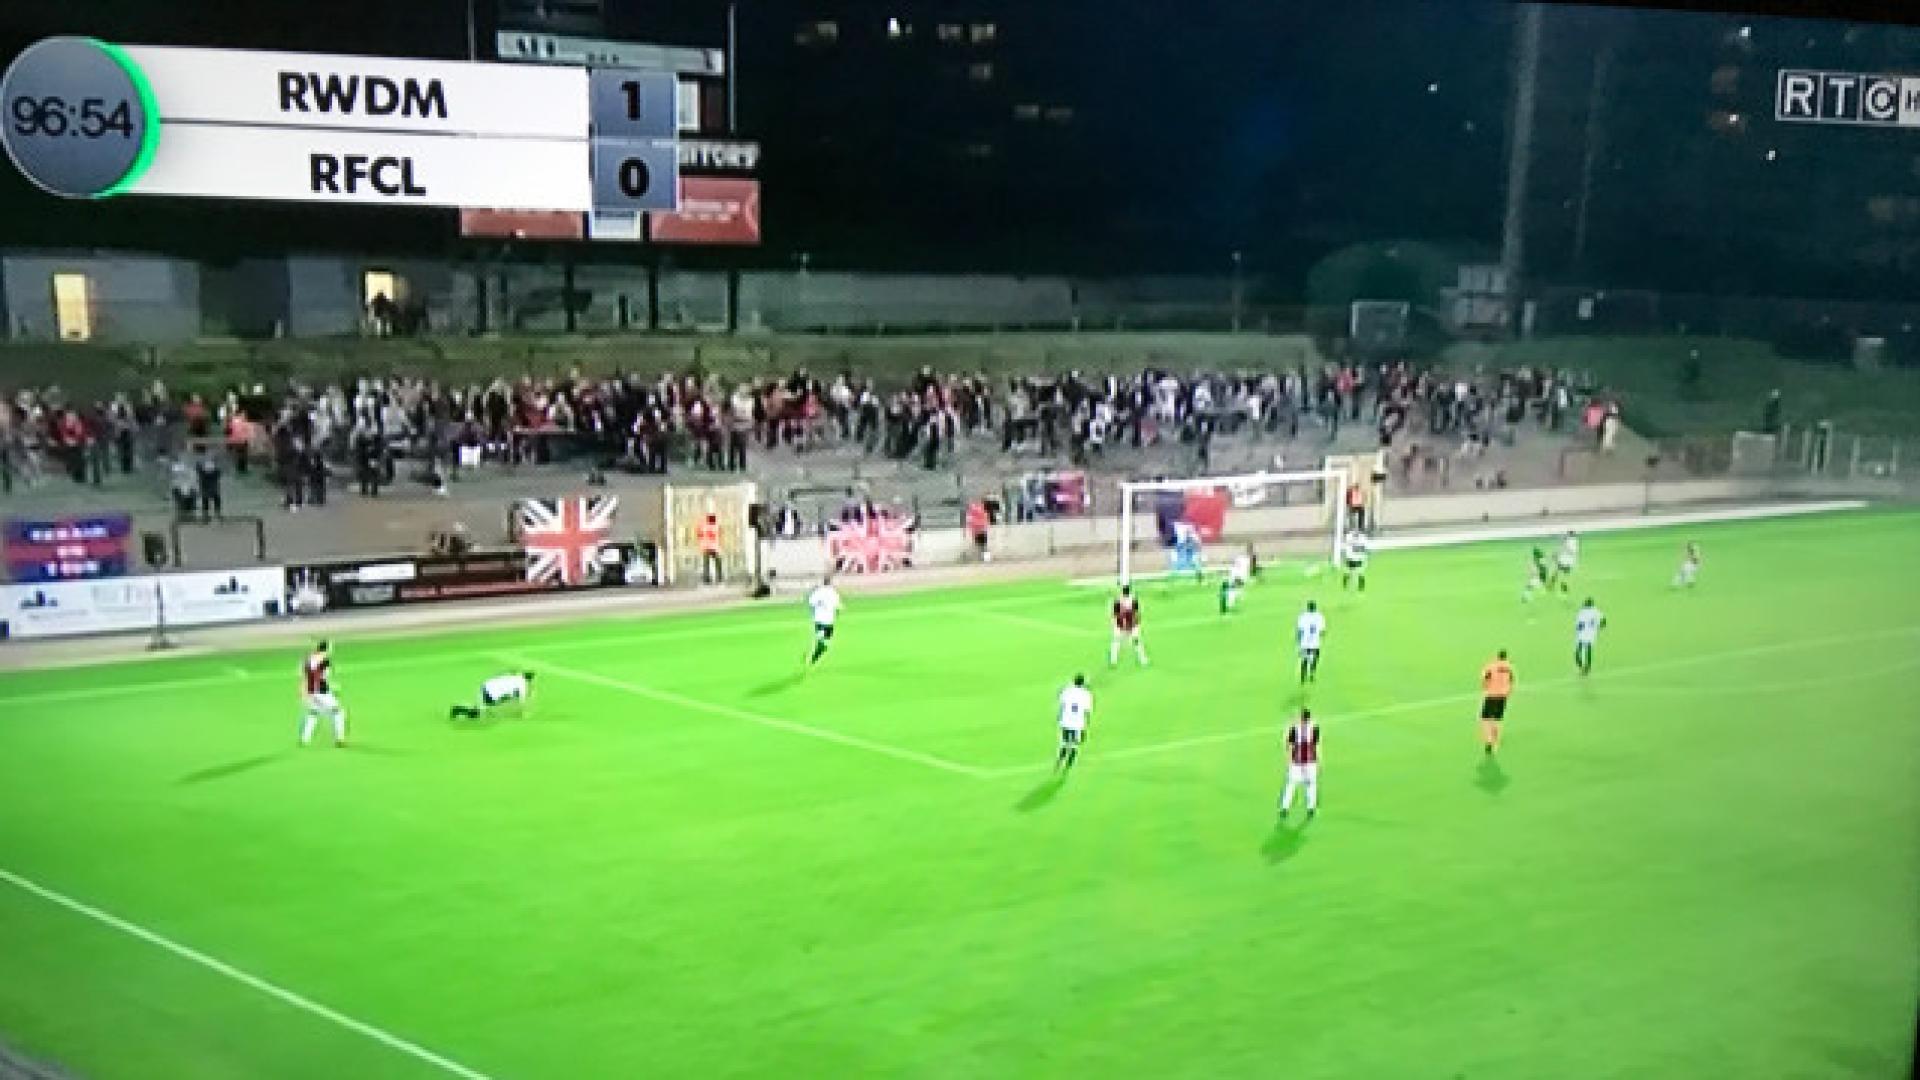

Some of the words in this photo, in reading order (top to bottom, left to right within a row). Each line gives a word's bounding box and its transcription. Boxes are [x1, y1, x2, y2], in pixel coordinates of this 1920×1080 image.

[12, 95, 134, 139] 96:54
[278, 72, 447, 119] RWDM
[621, 81, 641, 121] 1
[1784, 77, 1897, 119] RTC
[310, 154, 427, 196] RFCL
[618, 157, 650, 198] 0
